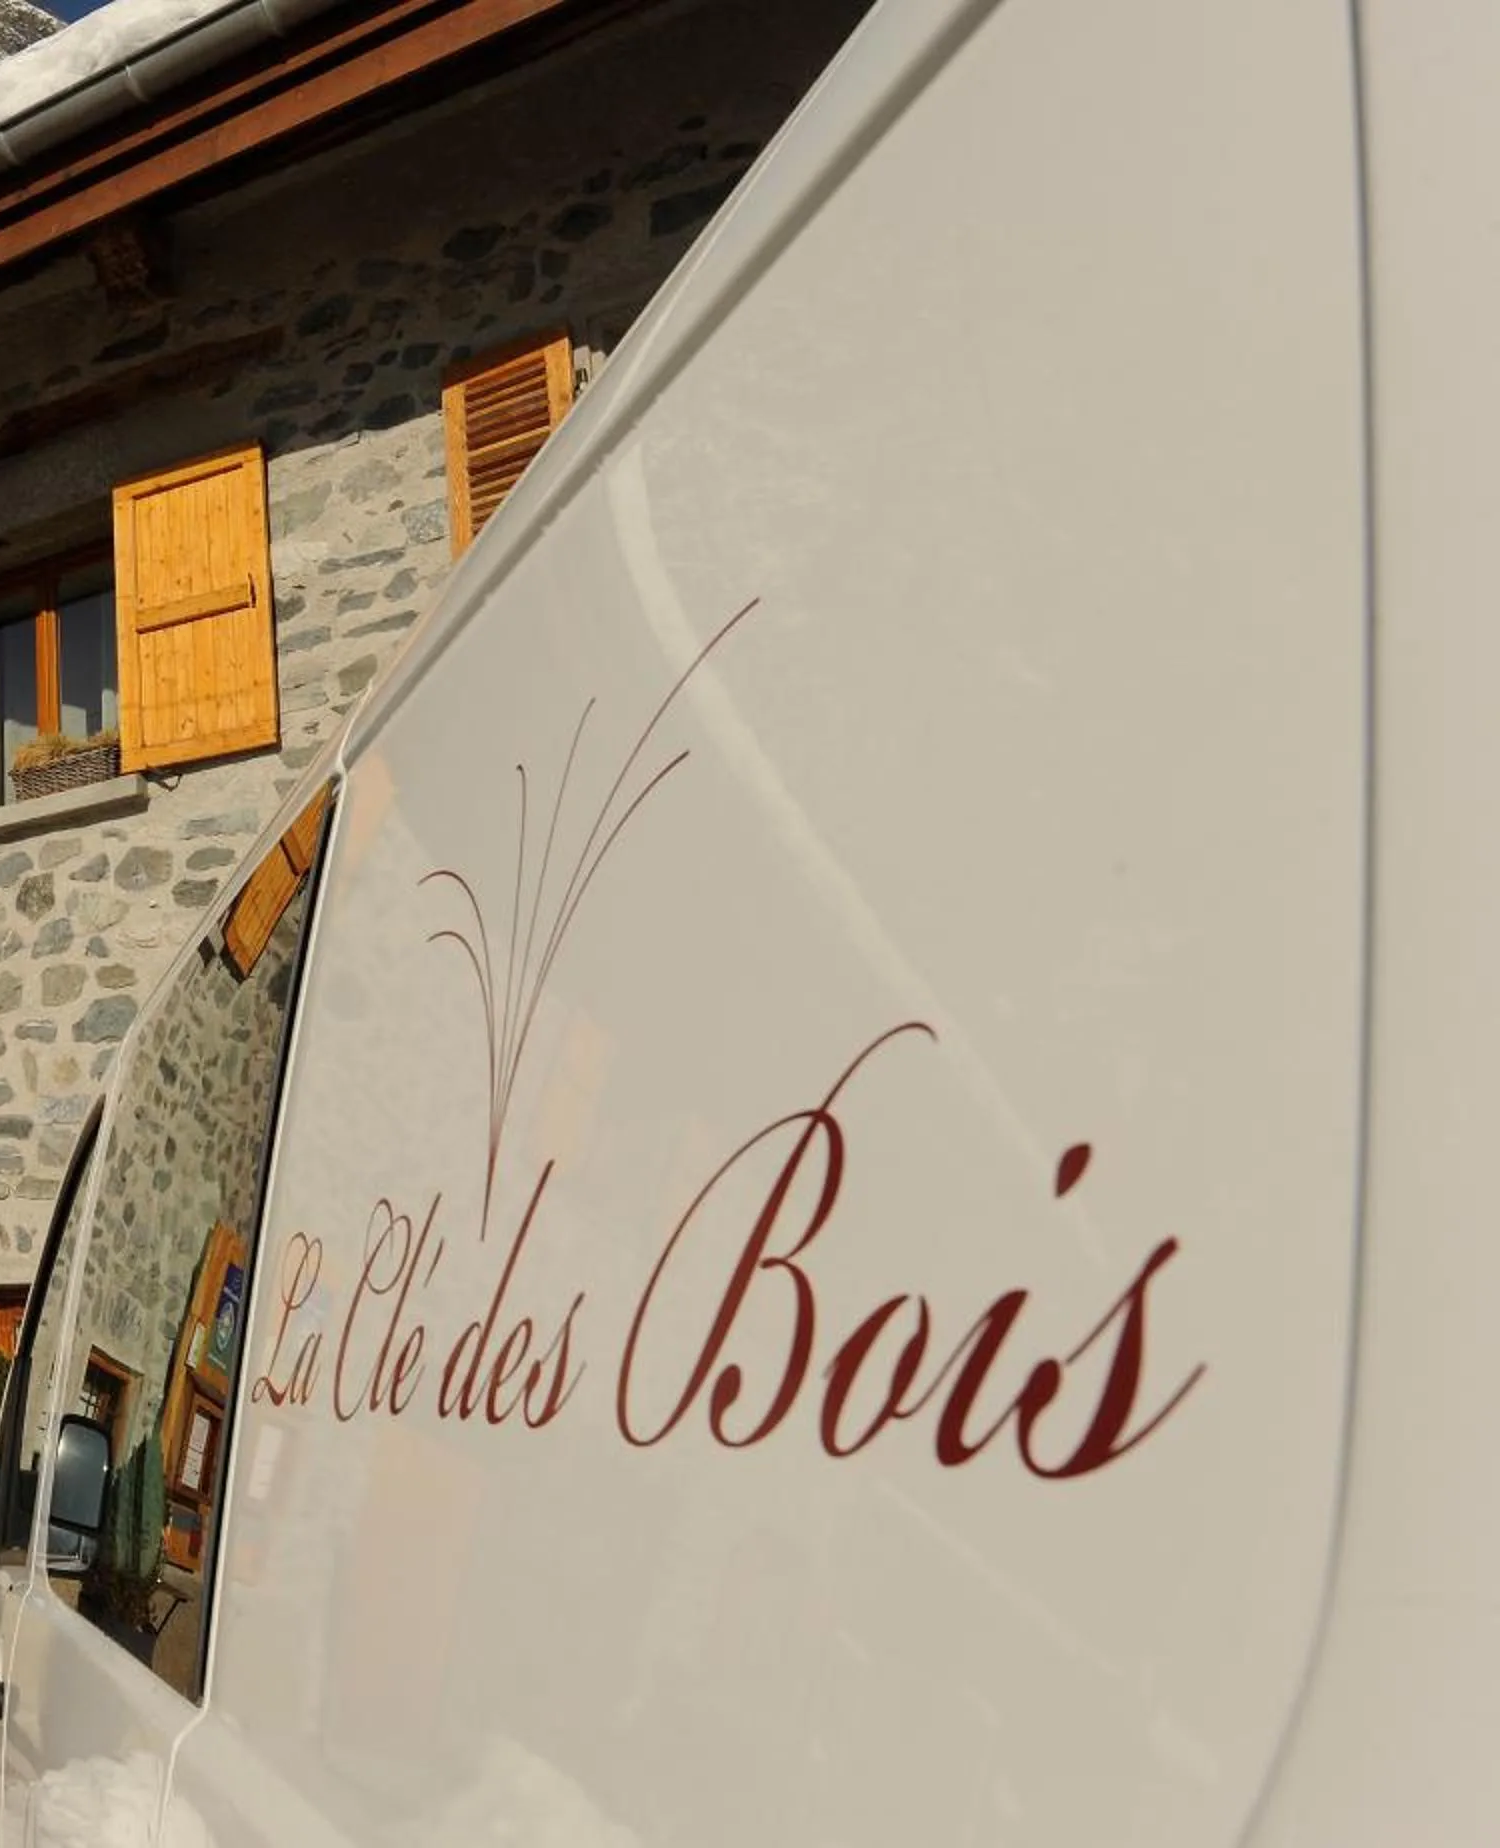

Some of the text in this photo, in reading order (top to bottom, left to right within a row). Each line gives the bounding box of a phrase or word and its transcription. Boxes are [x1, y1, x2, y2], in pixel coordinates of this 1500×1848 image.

[251, 1022, 1208, 1480] La Clé des Bois
